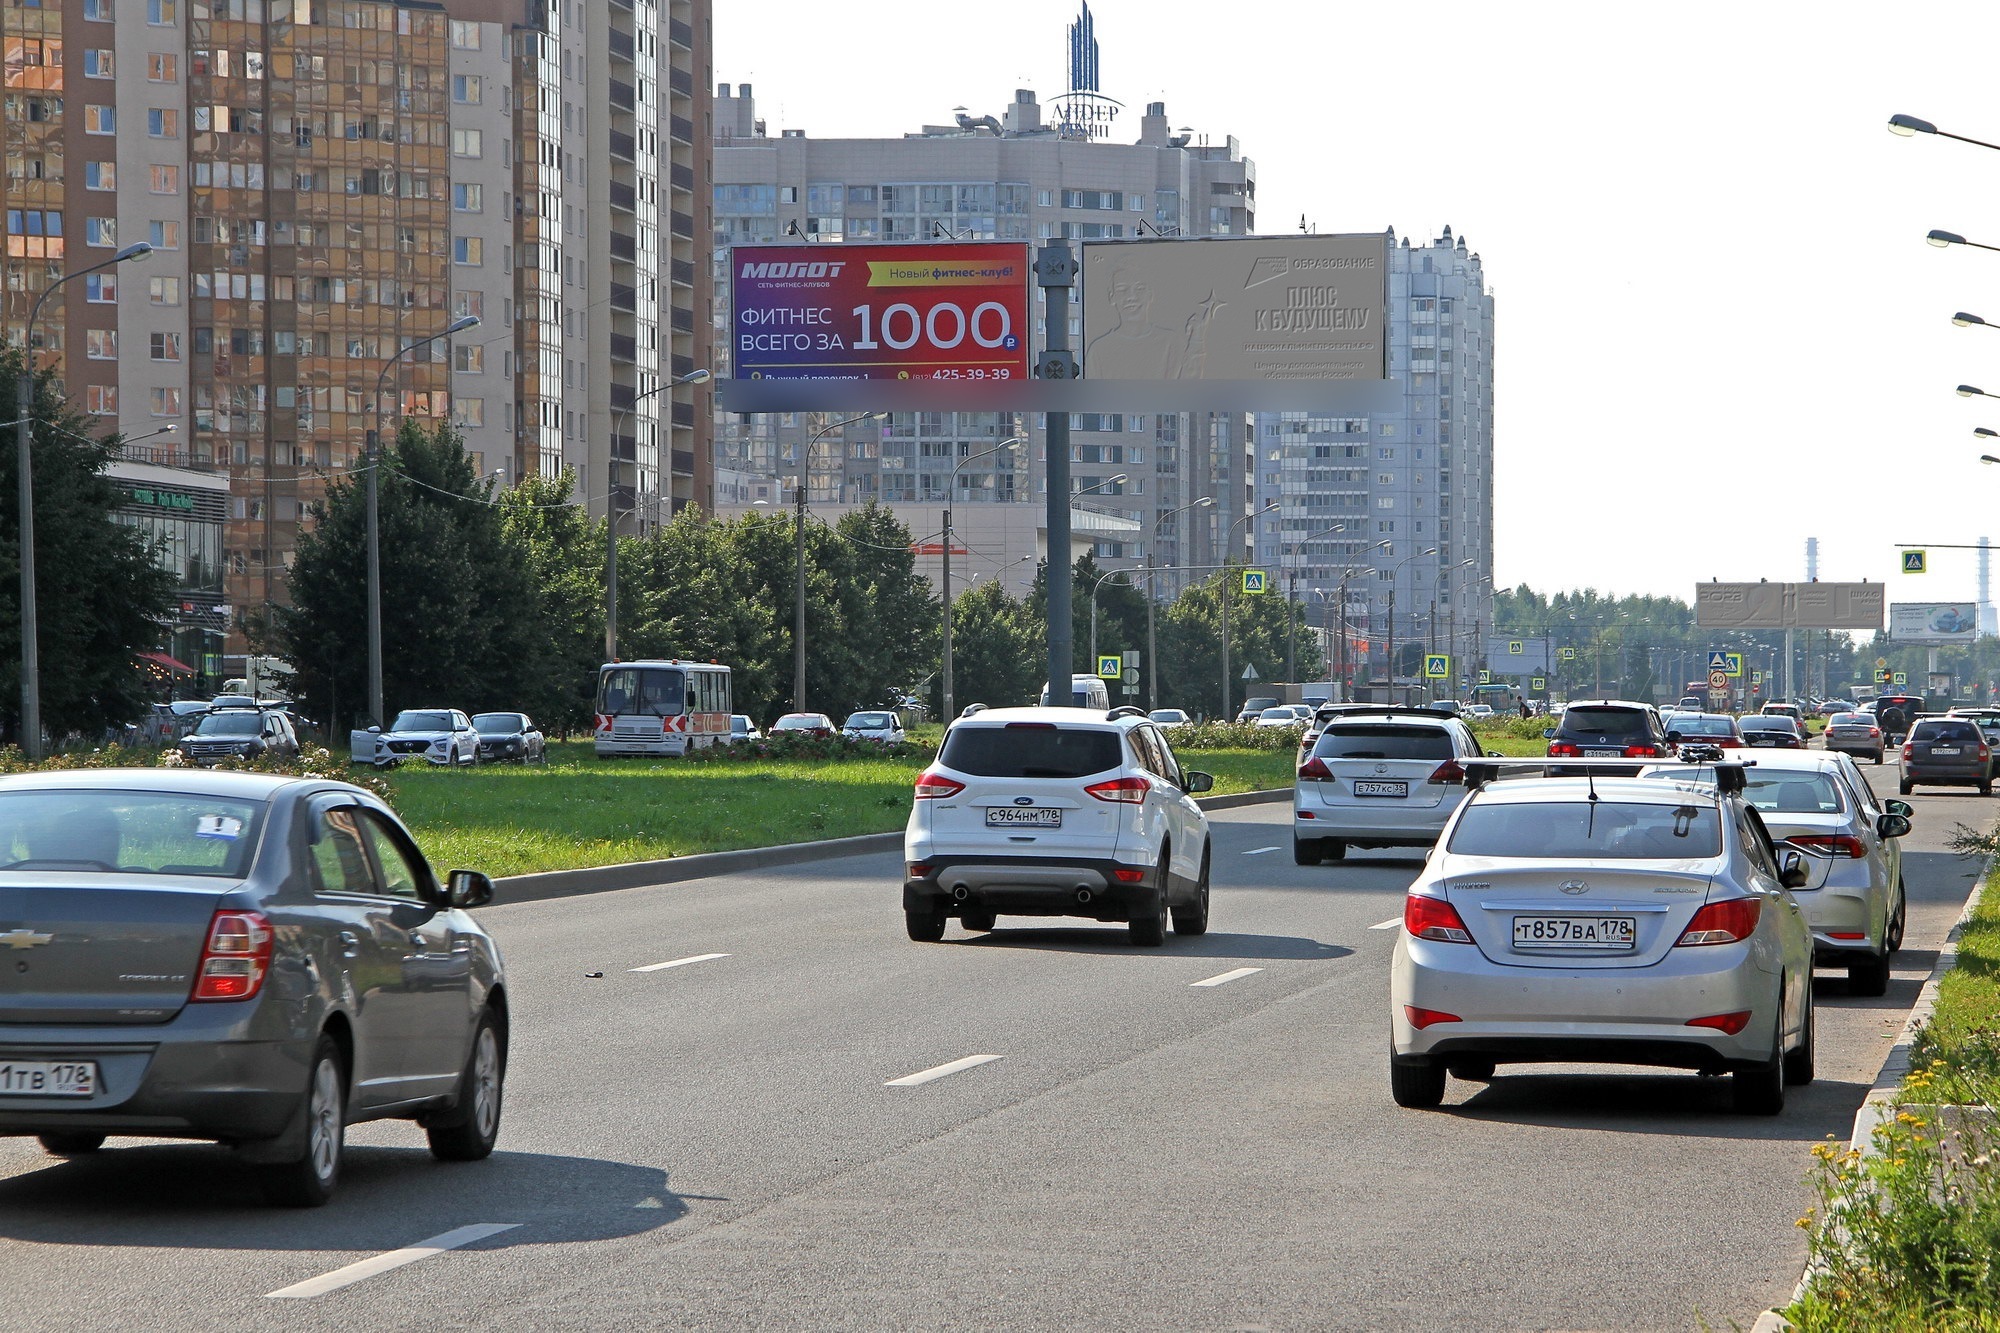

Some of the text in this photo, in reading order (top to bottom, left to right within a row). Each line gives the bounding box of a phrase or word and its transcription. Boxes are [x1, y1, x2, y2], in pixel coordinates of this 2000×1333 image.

[741, 262, 846, 278] МОЛОТ
[1293, 258, 1375, 269] ОБРАЗОВАНИЕ
[890, 266, 1013, 280] Новый фитнес-клуб!
[1286, 286, 1338, 308] ПЛЮС
[741, 307, 832, 325] ФИТНЕС
[1255, 308, 1370, 333] К БУДУЩЕМУ
[852, 302, 1010, 349] 1000
[741, 333, 844, 351] ВСЕГО ЗА
[932, 368, 1010, 380] 425-39-39
[1712, 675, 1724, 683] 40
[1040, 809, 1057, 819] 178
[1600, 920, 1628, 935] 178
[52, 1065, 87, 1083] 178
